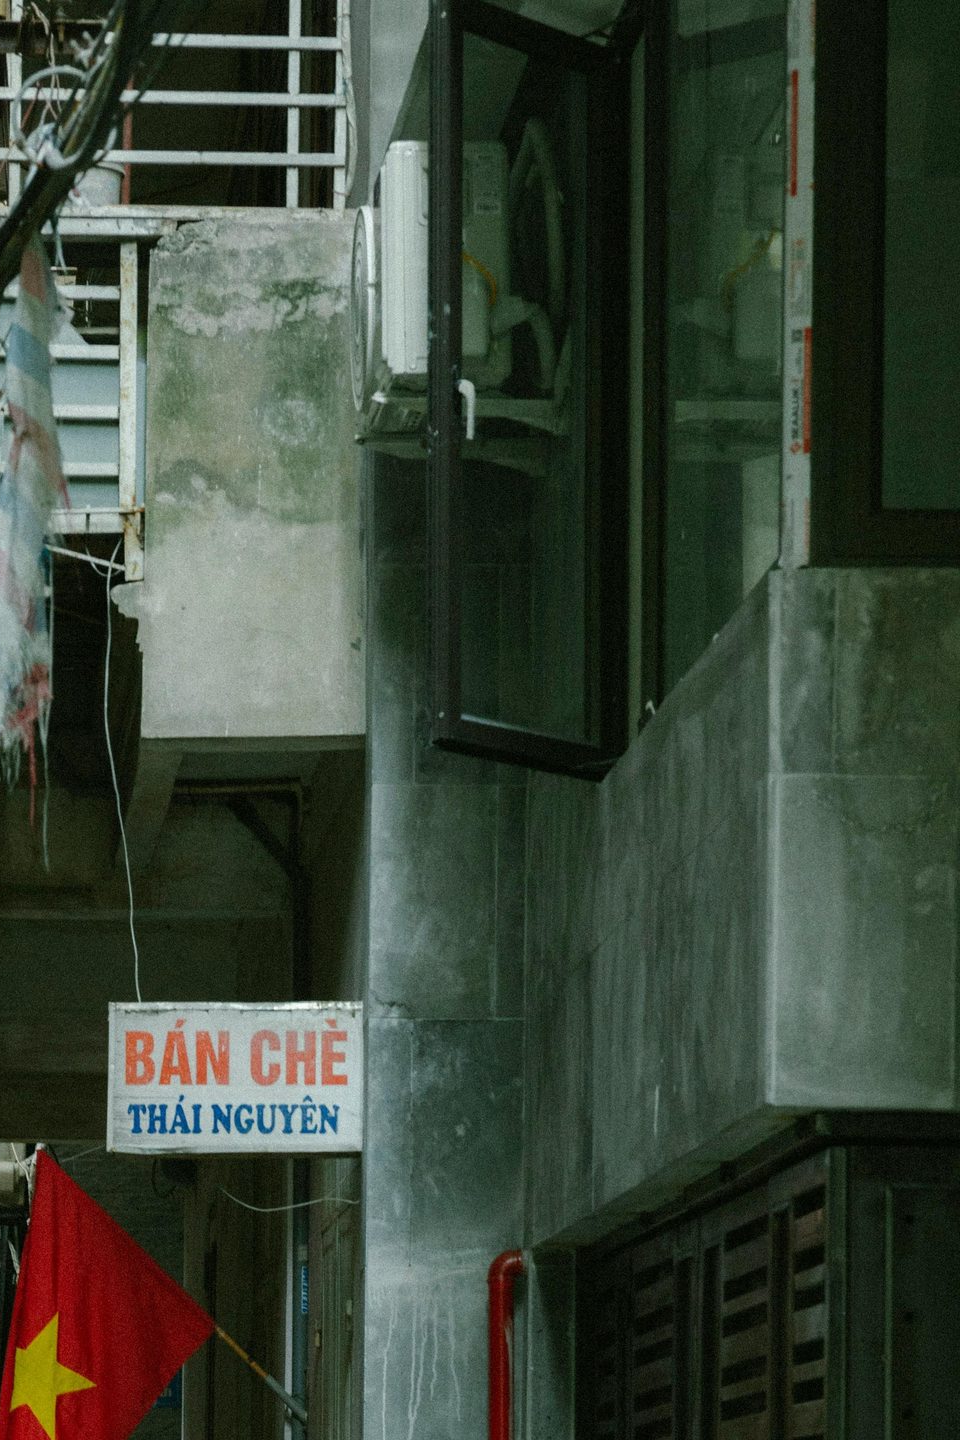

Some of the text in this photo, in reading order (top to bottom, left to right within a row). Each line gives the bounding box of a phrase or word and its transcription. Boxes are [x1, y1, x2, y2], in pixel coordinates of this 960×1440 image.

[125, 1018, 348, 1086] BÁN CHÈ
[128, 1095, 340, 1135] THÁI NGUYÊN
